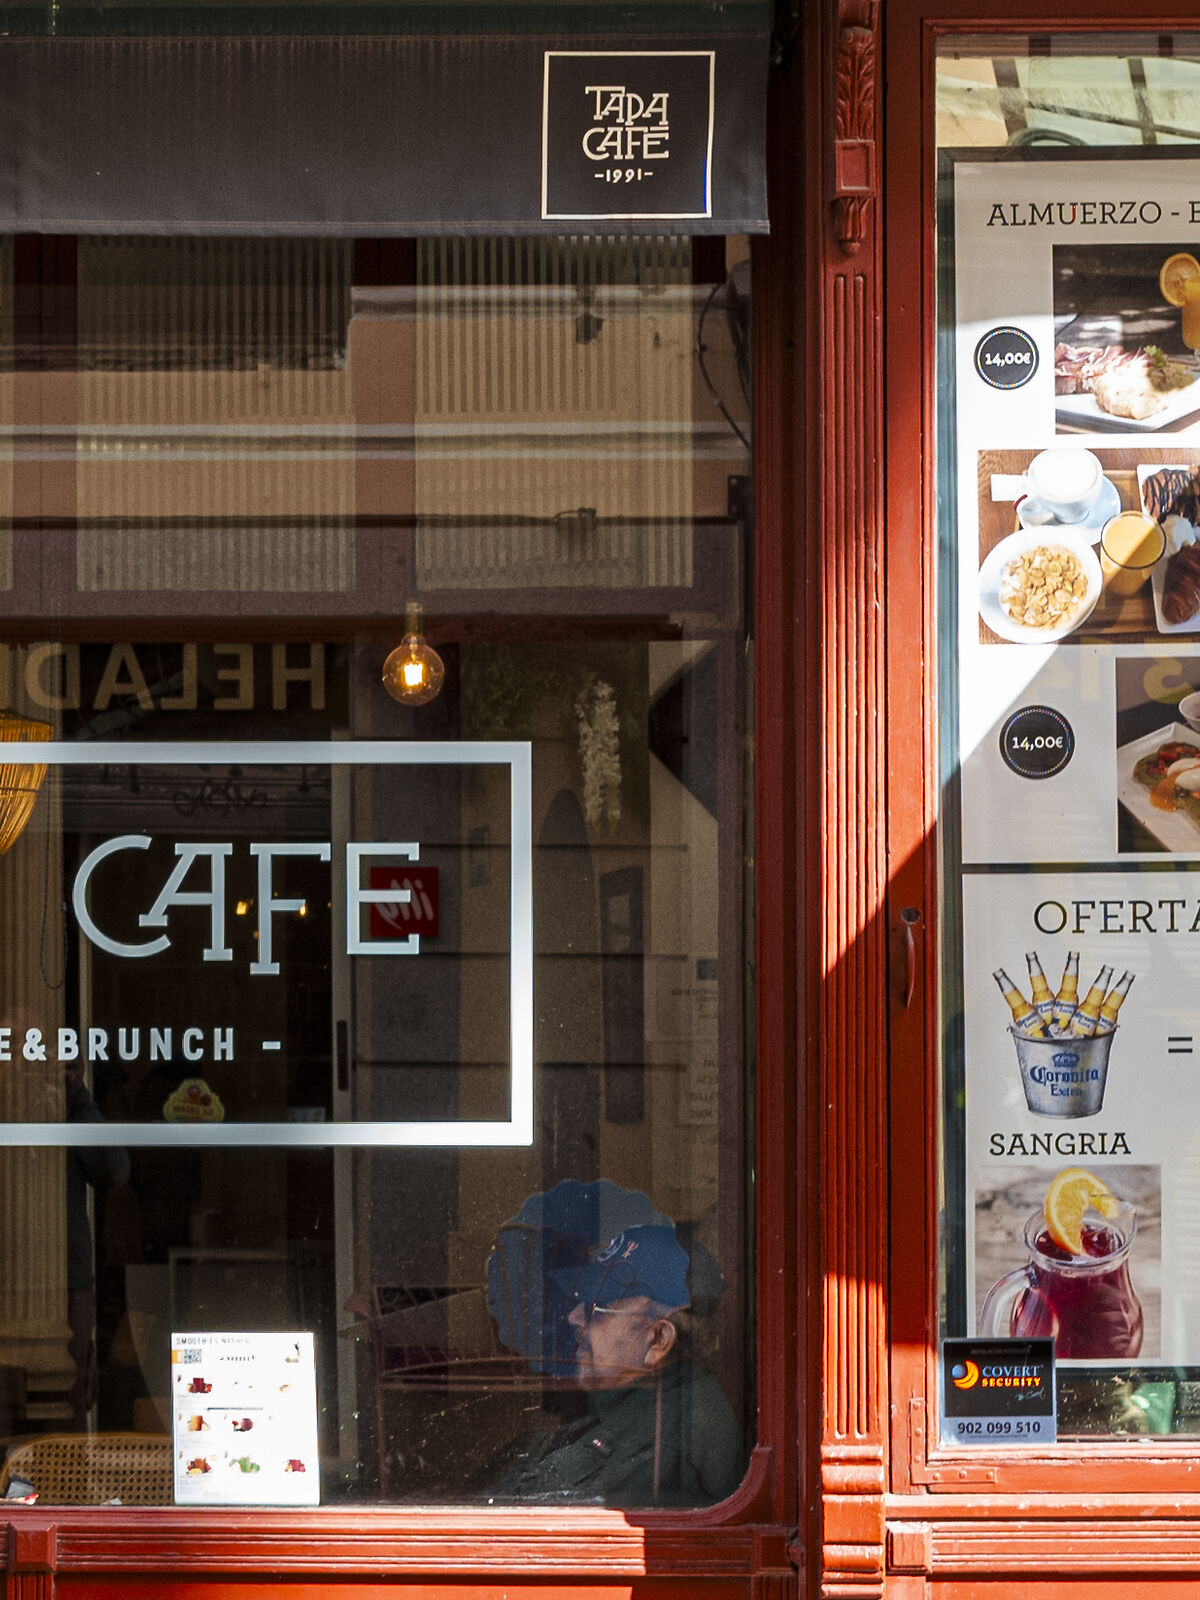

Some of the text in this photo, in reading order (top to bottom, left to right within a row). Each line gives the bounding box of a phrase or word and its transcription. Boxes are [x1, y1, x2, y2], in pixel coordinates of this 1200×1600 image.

[584, 85, 670, 126] TAPA
[986, 201, 1162, 227] ALMUERZO
[985, 352, 1031, 367] 14,00€
[1012, 736, 1064, 751] 14,00€
[73, 834, 420, 975] CAFE
[1029, 1064, 1099, 1086] Coronita
[989, 1131, 1132, 1156] SANGRIA
[981, 1365, 1040, 1377] COVERT
[981, 1377, 1041, 1388] SECURITY
[957, 1421, 1041, 1434] 902 099 510
